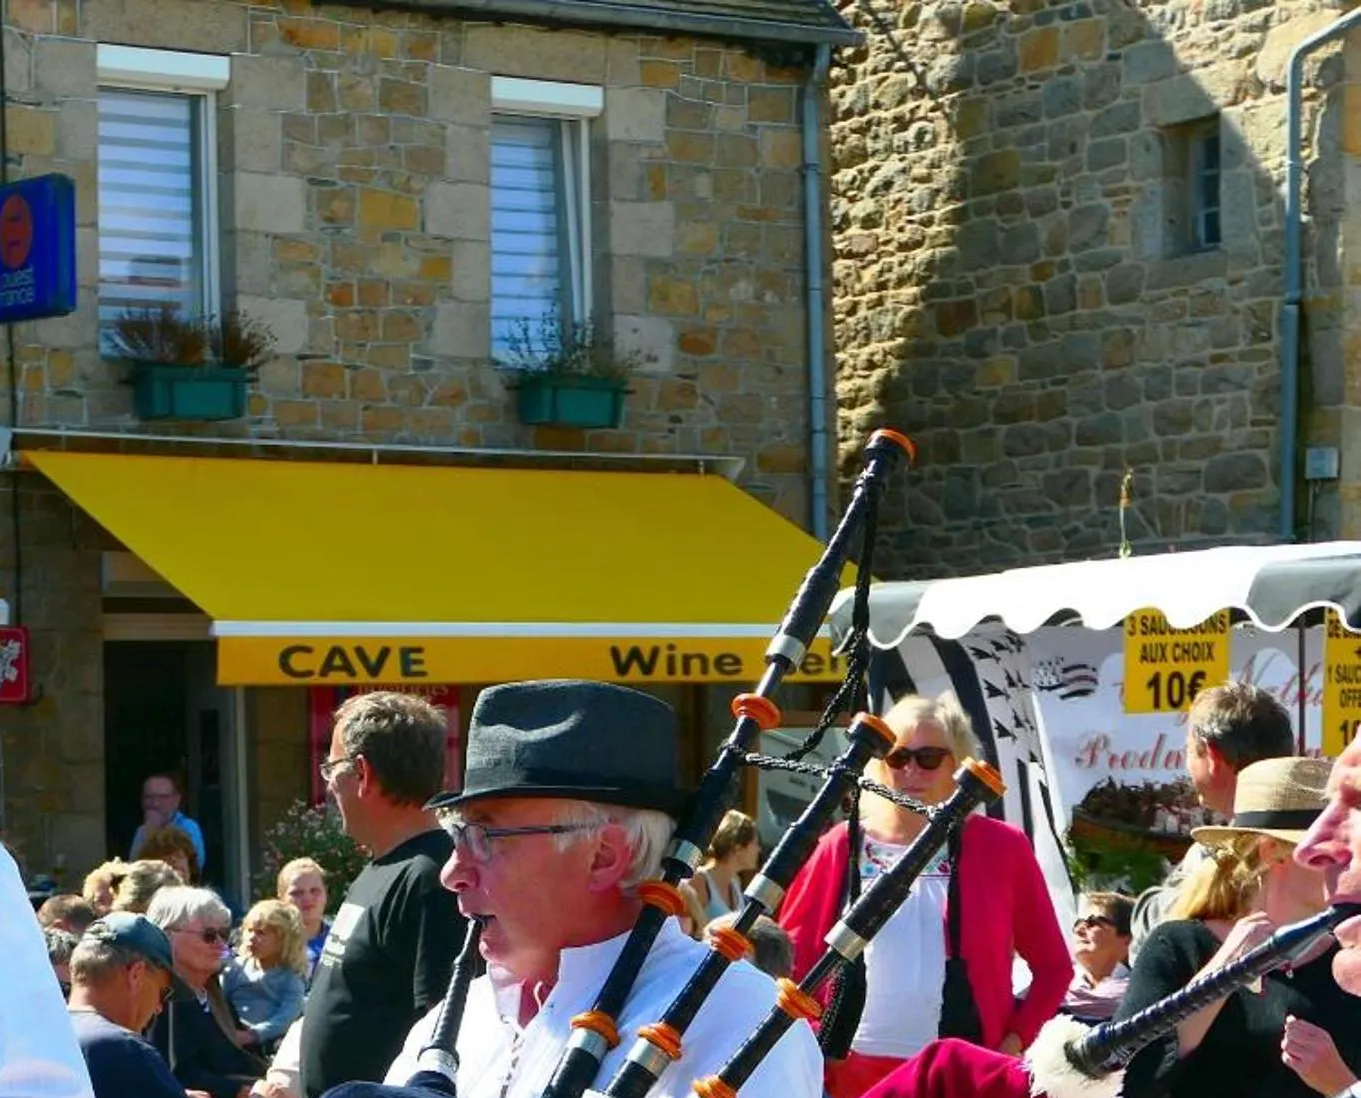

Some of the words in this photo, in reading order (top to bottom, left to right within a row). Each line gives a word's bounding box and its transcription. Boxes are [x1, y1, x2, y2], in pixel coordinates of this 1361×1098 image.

[1127, 616, 1137, 636] 3
[278, 645, 428, 678] CAVE
[610, 644, 743, 677] Wine
[1140, 642, 1167, 663] AUX
[1172, 641, 1215, 663] CHOIX
[1146, 669, 1207, 711] 10€
